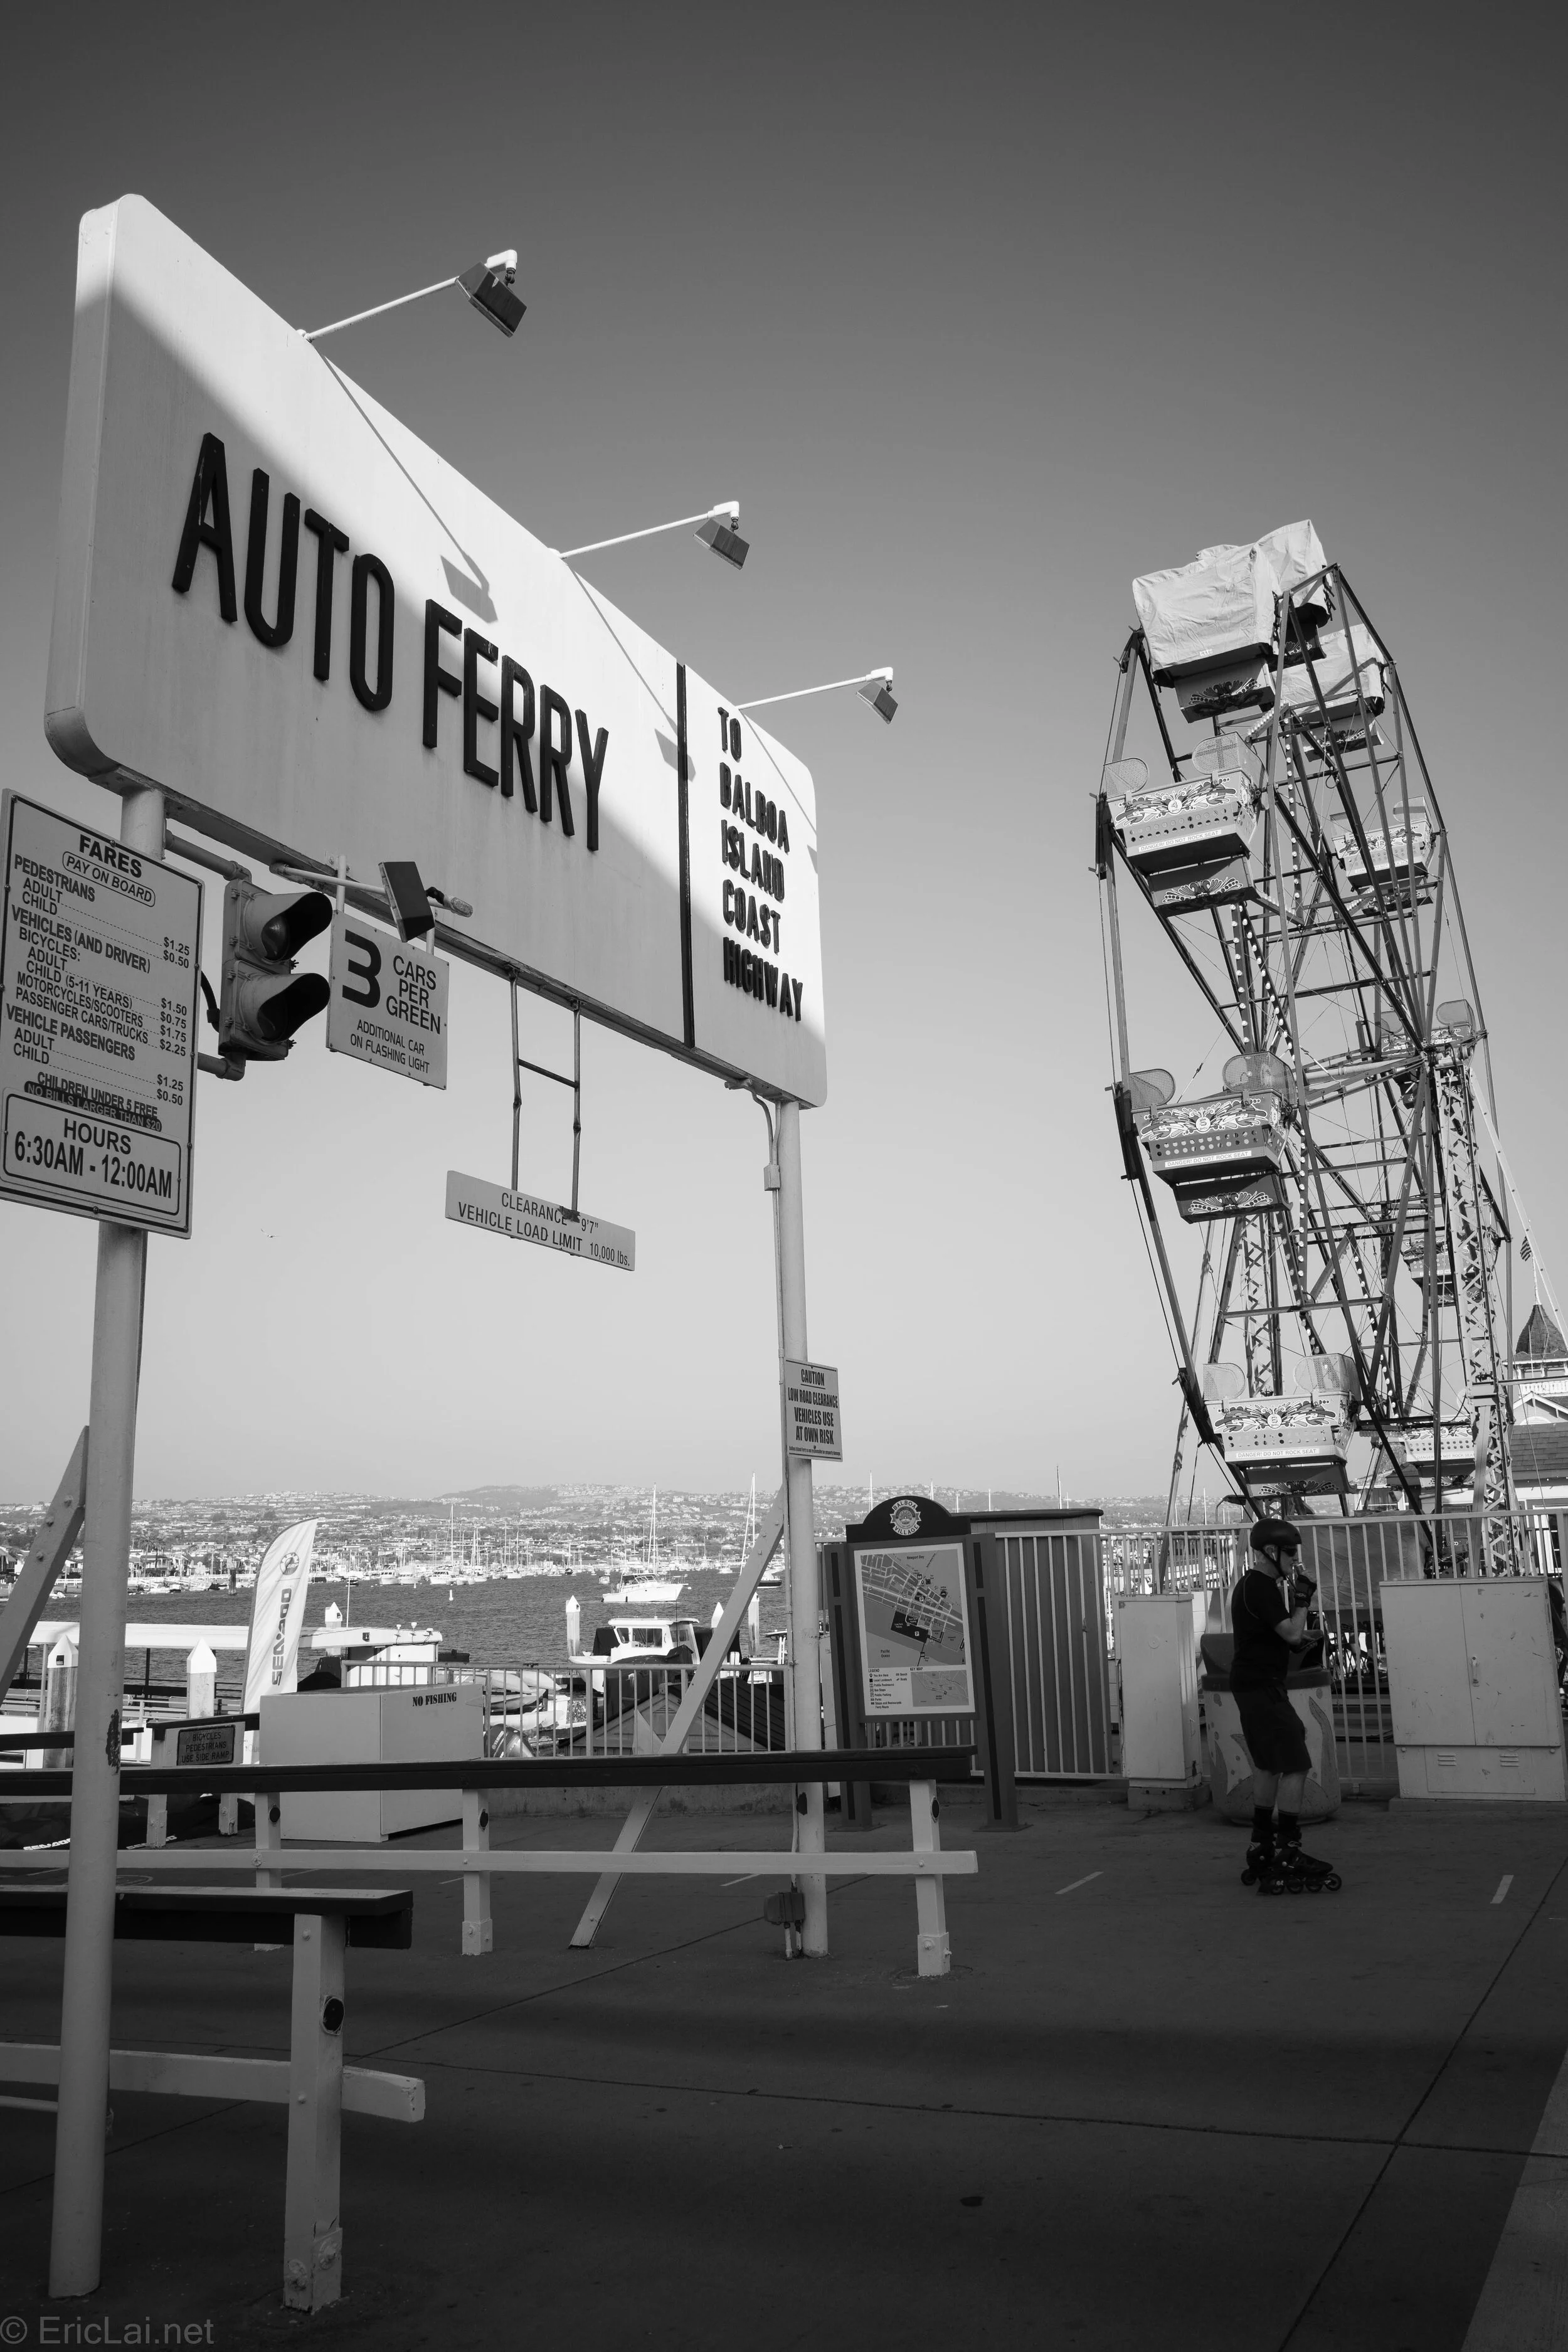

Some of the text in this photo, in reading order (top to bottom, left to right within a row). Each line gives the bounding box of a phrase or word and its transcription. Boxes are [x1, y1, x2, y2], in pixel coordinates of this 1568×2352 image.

[172, 432, 608, 852] AUTO FERRY
[718, 707, 741, 760] TO
[719, 761, 789, 854] BALBOA
[80, 834, 142, 877] FARES
[721, 819, 784, 901] ISLAND
[1141, 842, 1165, 850] DANGER!
[14, 854, 95, 901] PEDESTRIANS
[66, 856, 152, 902] PAY ON BOARD
[12, 905, 151, 973] VEHICLES (AND DRIVER)
[23, 891, 189, 968] CHILD $0.50
[24, 878, 189, 955] ADULT $1.25
[723, 879, 780, 955] COAST
[19, 927, 80, 961] BICYCLES:
[29, 946, 187, 1016] ADULT $1.50
[342, 930, 381, 1008] 3
[394, 956, 437, 990] CARS
[723, 936, 803, 1021] HIGHWAY
[18, 972, 186, 1042] MOTORCYCLES/SCOOTERS $1.75
[26, 960, 186, 1029] CHILD (5-11 YEARS) $0.75
[386, 995, 440, 1034] GREEN
[400, 978, 429, 1009] PER
[7, 1004, 135, 1060] VEHICLE PASSENGERS
[16, 987, 186, 1056] PASSENGER CARS/TRUCKS $2.25
[358, 1019, 425, 1056] ADDITIONAL CAR
[14, 1027, 183, 1091] ADULT $1.25
[14, 1043, 183, 1105] CHILD $0.50
[351, 1034, 429, 1074] ON FLASHING LIGHT
[28, 1085, 161, 1131] NO BILLS LARGER THAN $20
[38, 1071, 157, 1117] CHILDREN UNDER 5 FREE
[64, 1118, 131, 1154] HOURS
[15, 1131, 83, 1176] 6:30AM
[102, 1154, 171, 1199] 12:00AM
[502, 1193, 567, 1226] CLEARANCE
[458, 1202, 630, 1266] VEHICLE LOAD LIMIT 10,000 lbs.
[788, 1387, 838, 1409] LOW ROAD CLEARANCE
[802, 1369, 824, 1386] CAUTION
[794, 1407, 834, 1426] VEHICLES USE
[796, 1426, 834, 1444] AT OWN RISK
[893, 1500, 916, 1510] BALBOA
[895, 1524, 918, 1535] VILLAGE
[413, 1692, 457, 1707] NO FISHING
[182, 1751, 230, 1763] USE SIDE RAMP
[186, 1741, 226, 1752] PEDESTRIANS
[193, 1732, 221, 1741] BICYCLES
